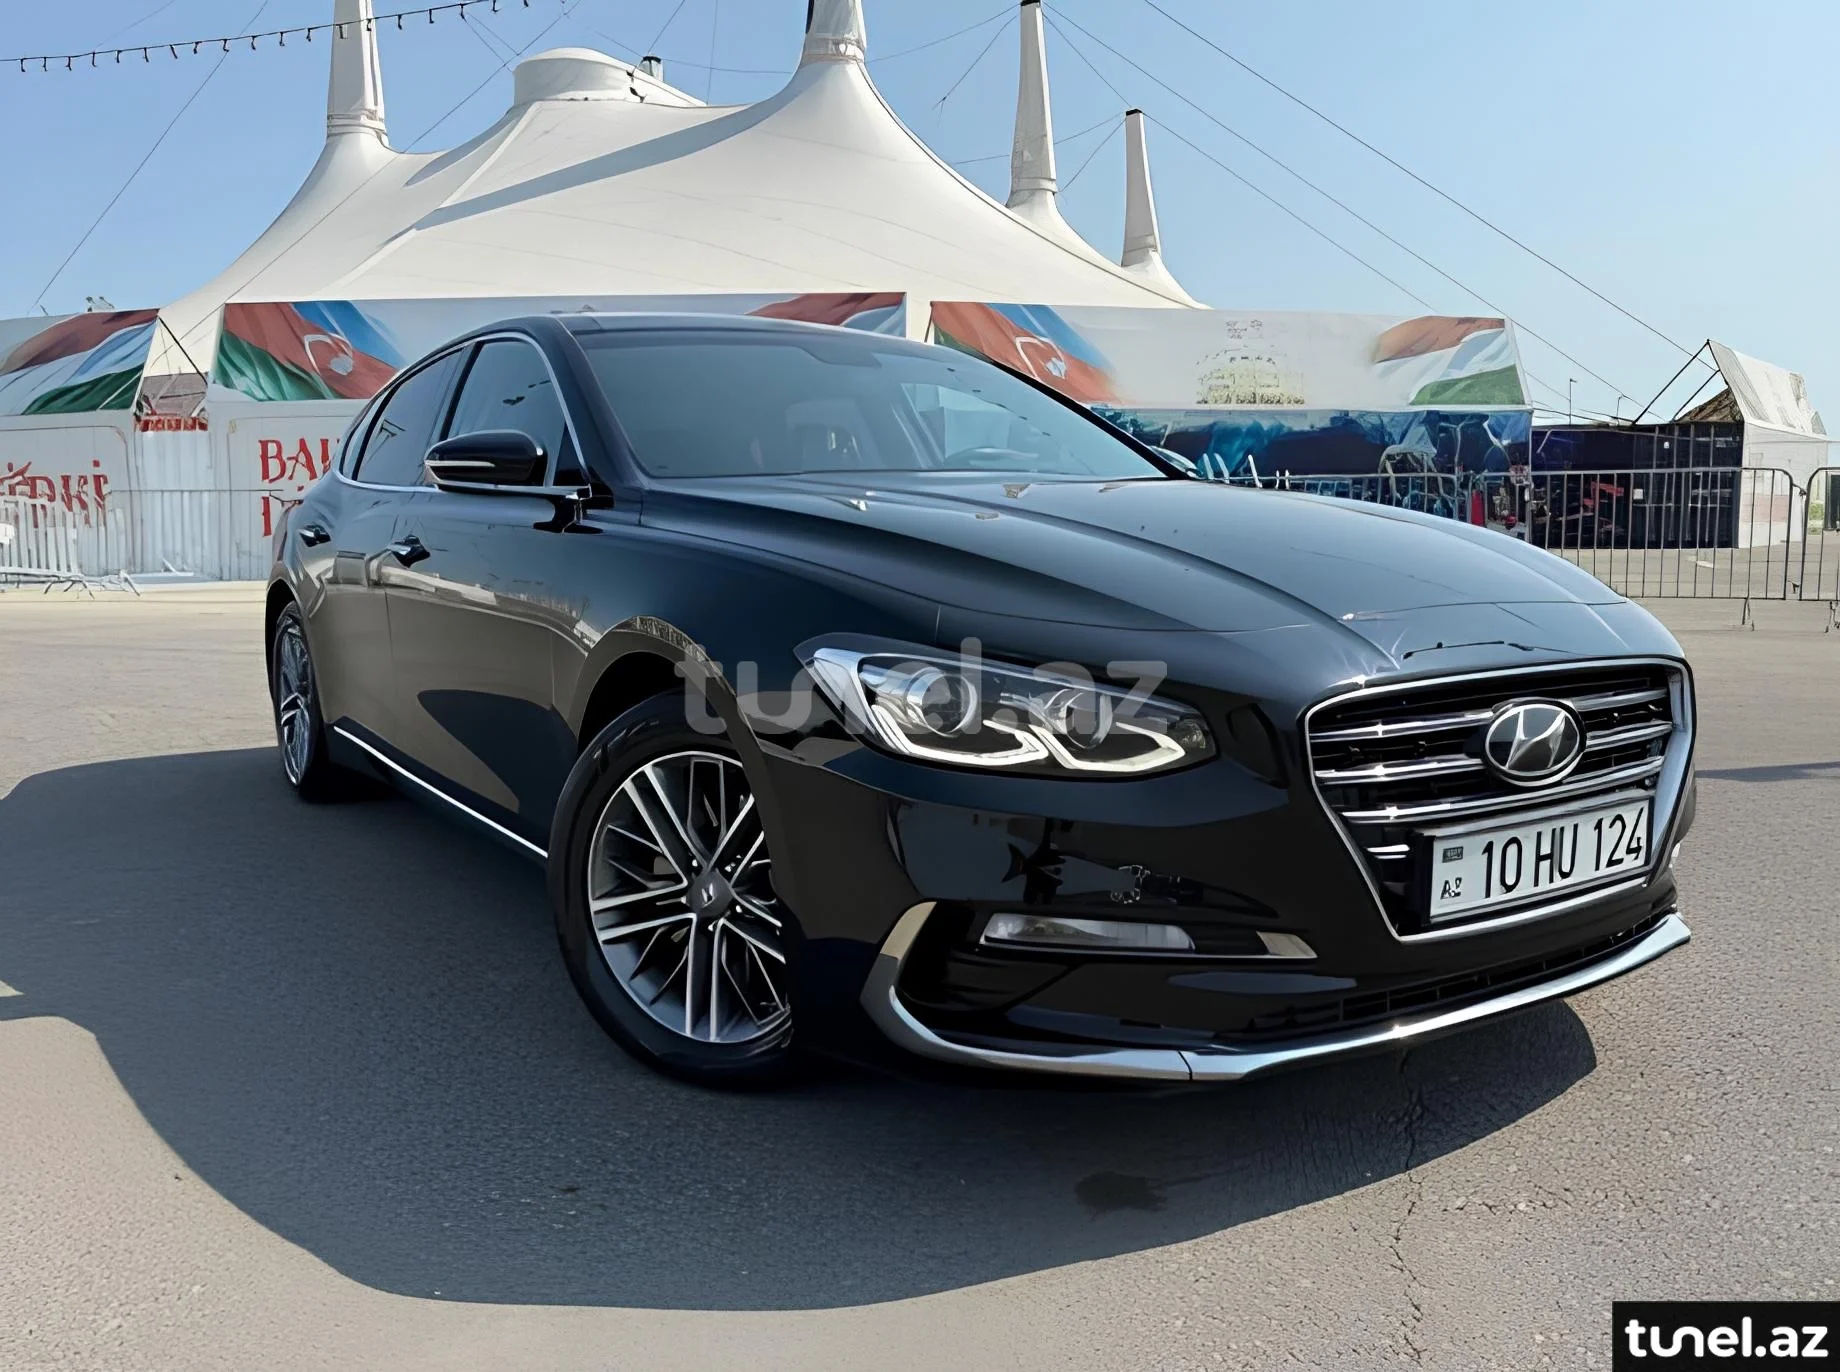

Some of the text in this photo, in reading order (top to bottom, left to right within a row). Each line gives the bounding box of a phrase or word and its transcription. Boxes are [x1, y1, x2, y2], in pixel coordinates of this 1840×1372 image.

[1481, 806, 1644, 898] 10 HU 124
